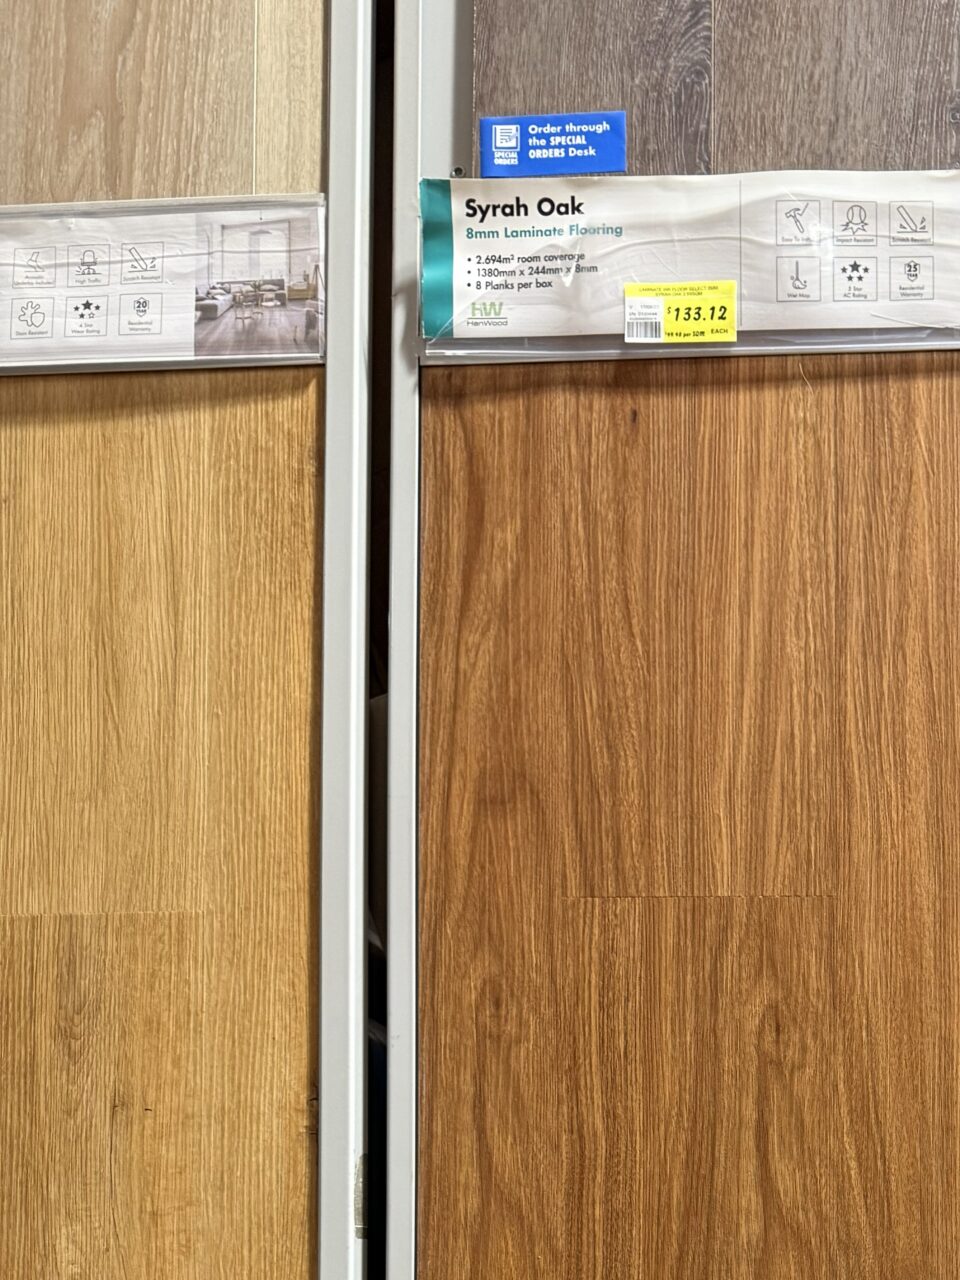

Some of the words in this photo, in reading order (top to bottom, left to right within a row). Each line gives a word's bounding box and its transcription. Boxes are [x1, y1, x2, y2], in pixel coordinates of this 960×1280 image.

[528, 124, 562, 135] Order
[565, 121, 611, 135] through
[528, 137, 546, 147] the
[550, 134, 587, 146] SPECIAL
[528, 147, 566, 158] ORDERS
[569, 146, 597, 157] Desk
[465, 196, 529, 222] Syrah
[537, 196, 584, 217] Oak
[466, 229, 499, 240] 8mm
[504, 227, 564, 239] Laminate
[569, 225, 623, 239] Flooring
[517, 256, 542, 265] room
[544, 253, 585, 267] coverage
[667, 305, 728, 322] $133.12
